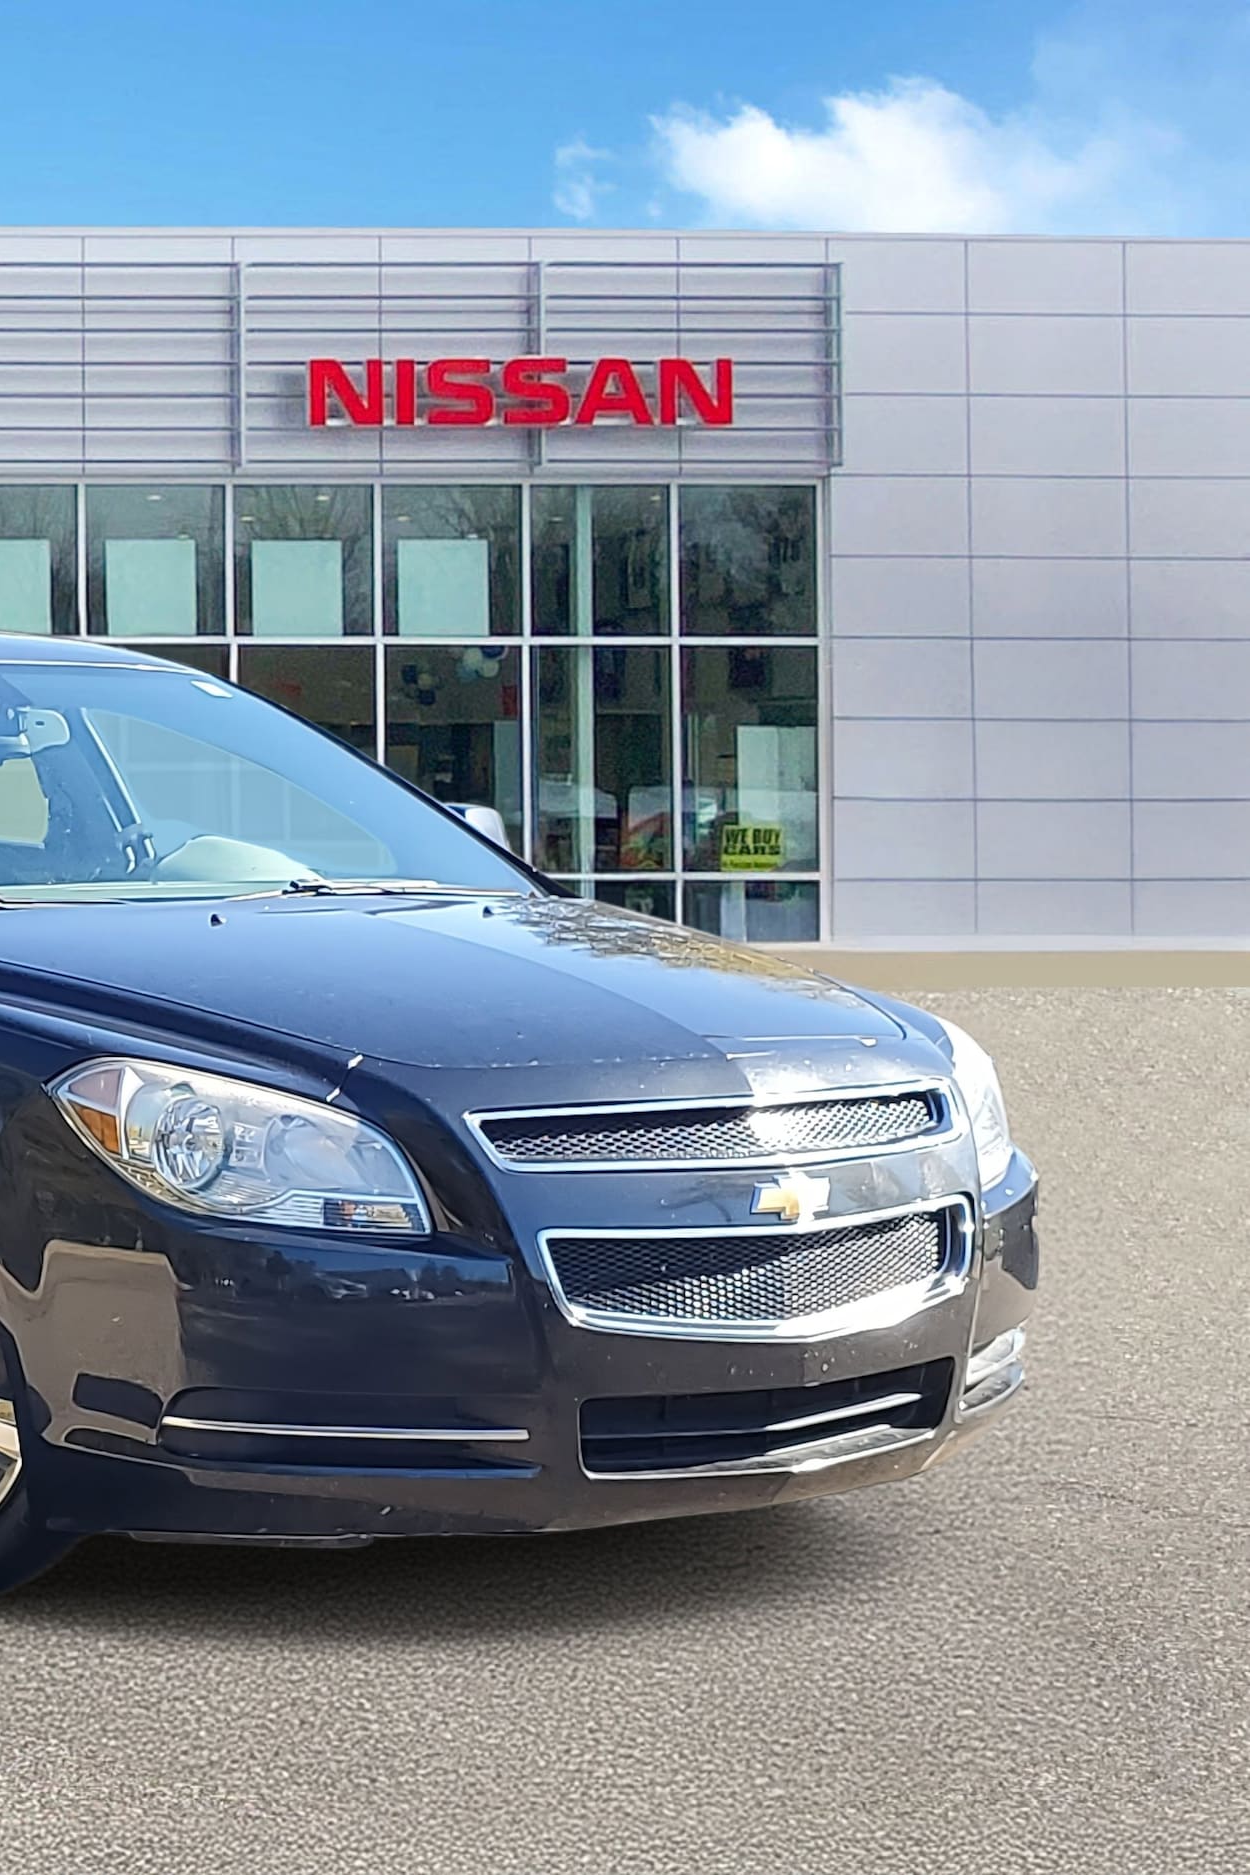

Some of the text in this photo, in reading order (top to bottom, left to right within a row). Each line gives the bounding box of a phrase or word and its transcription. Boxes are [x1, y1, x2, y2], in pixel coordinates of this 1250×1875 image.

[308, 357, 734, 427] NISSAN
[725, 828, 781, 844] WE BUY
[724, 845, 781, 855] CARS
